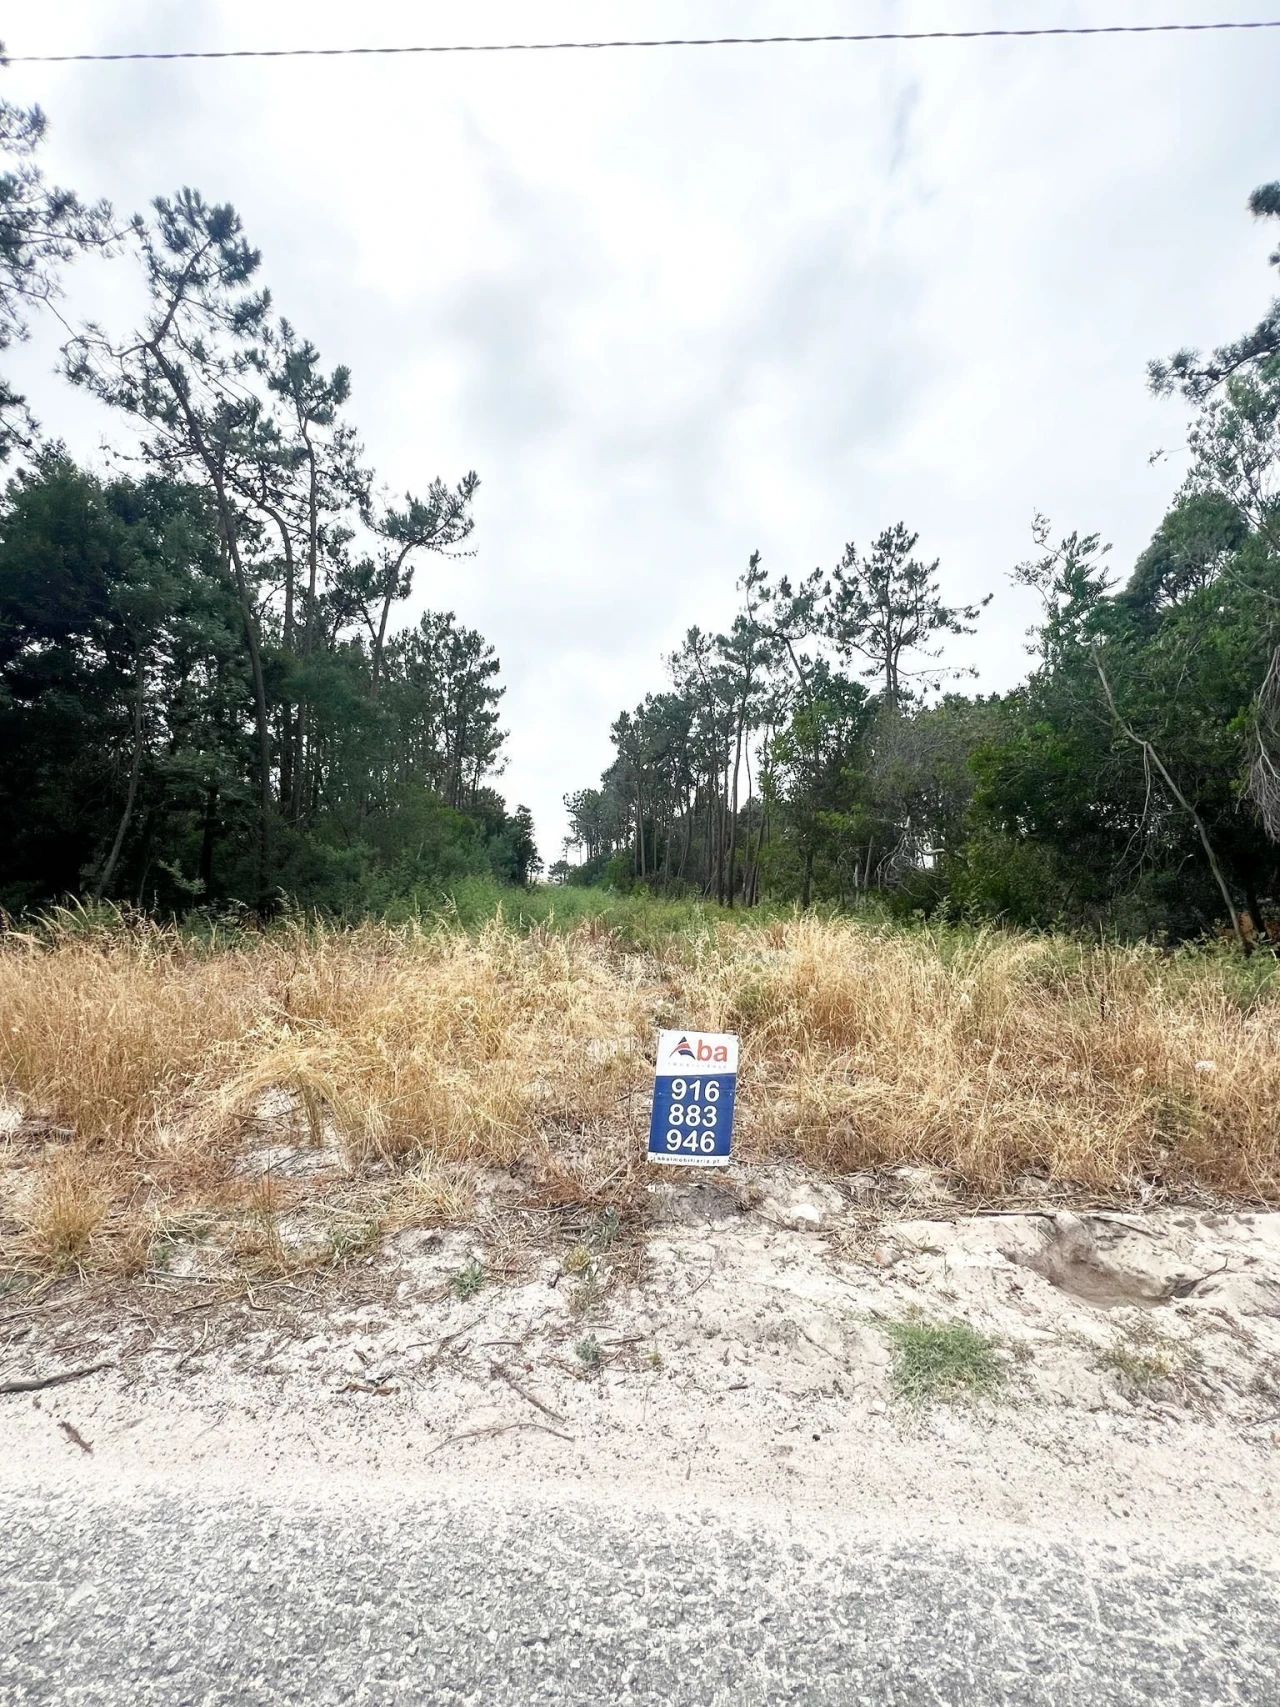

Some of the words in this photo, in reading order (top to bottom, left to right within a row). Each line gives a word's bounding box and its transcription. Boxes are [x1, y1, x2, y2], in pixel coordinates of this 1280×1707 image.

[669, 1036, 728, 1062] Aba
[671, 1078, 720, 1102] 916
[668, 1103, 717, 1127] 883
[666, 1128, 716, 1153] 946
